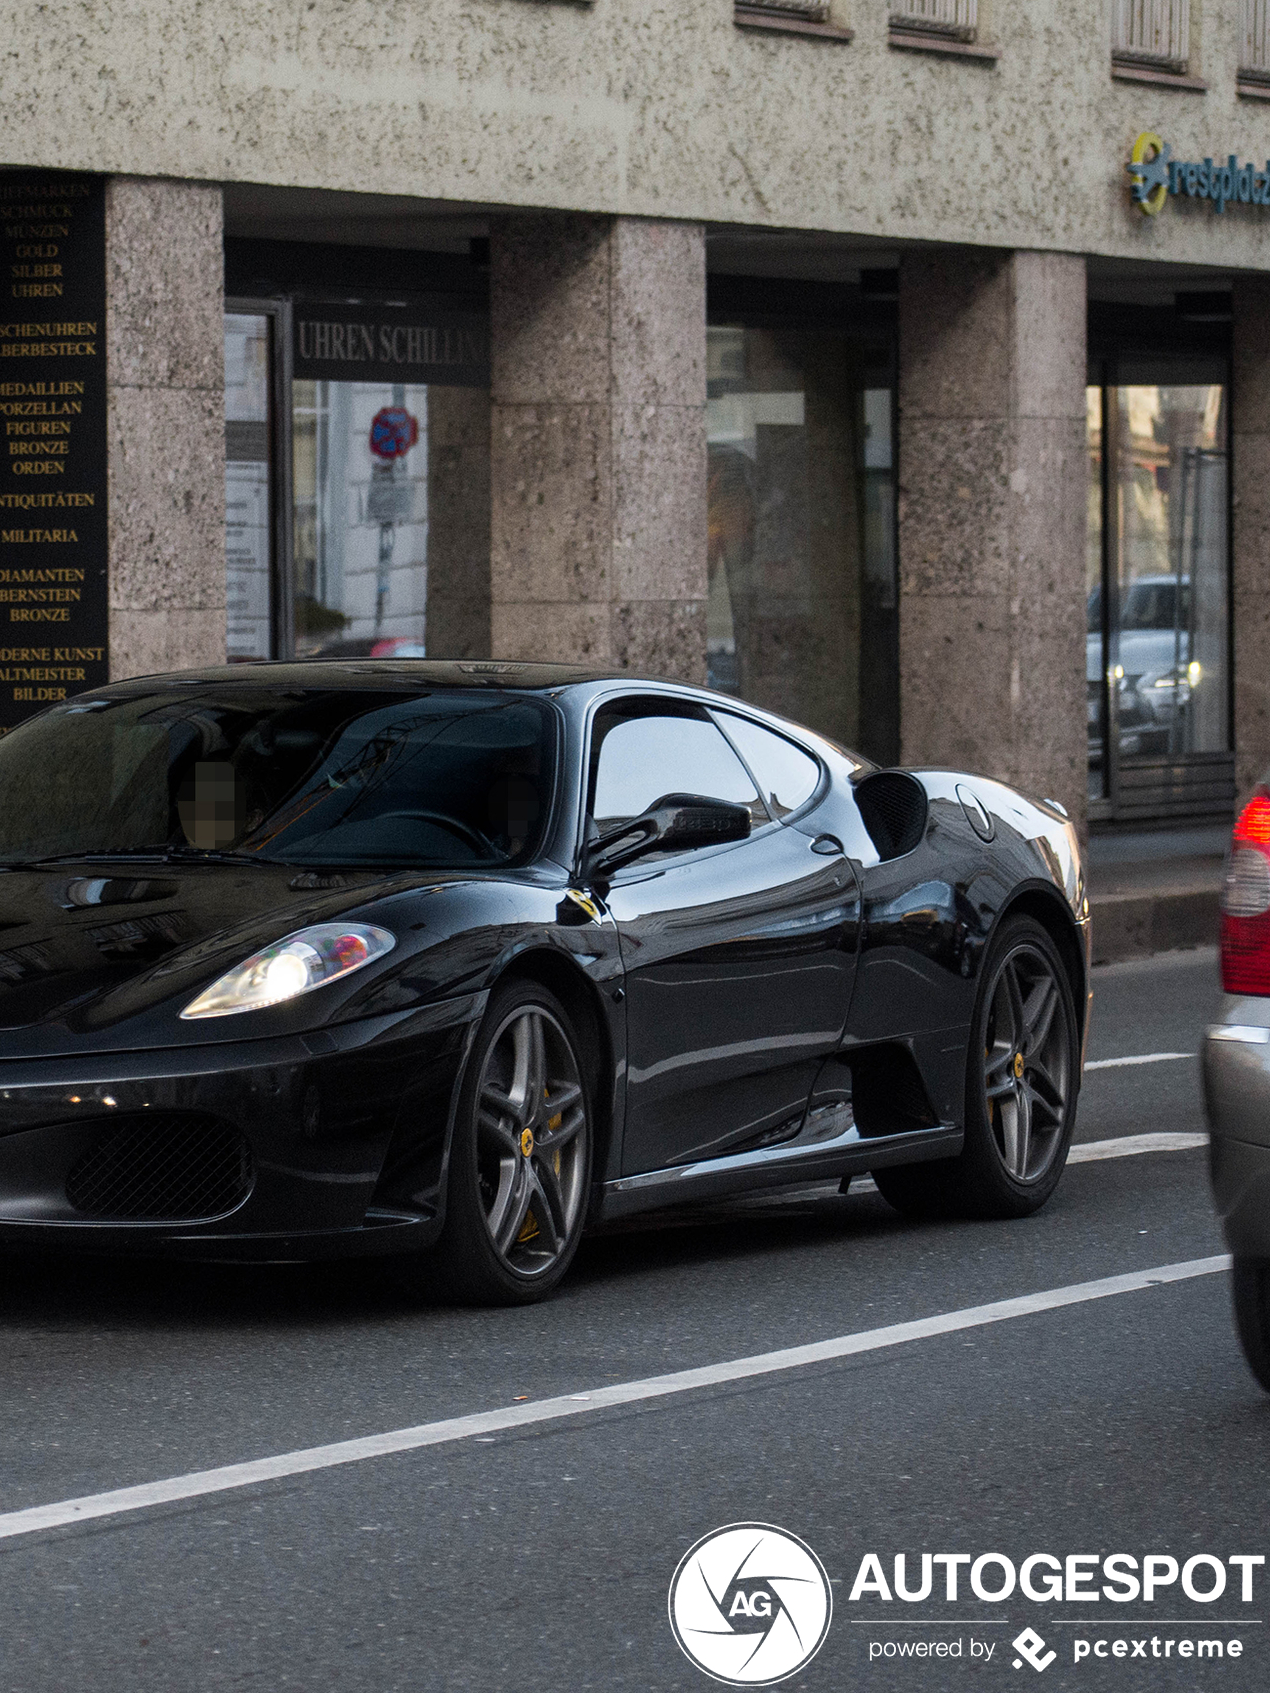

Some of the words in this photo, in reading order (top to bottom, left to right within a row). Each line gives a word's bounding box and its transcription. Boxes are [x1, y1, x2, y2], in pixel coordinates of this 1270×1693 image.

[0, 204, 72, 218] SCHMUCK
[16, 243, 58, 258] GOLD
[11, 263, 63, 277] SILBER
[12, 283, 64, 298] UHREN
[298, 321, 374, 361] UHREN
[6, 421, 71, 435] FIGUREN
[9, 441, 69, 455] BRONZE
[12, 461, 65, 475] ORDEN
[1, 529, 79, 544] MILITARIA
[0, 588, 81, 603] BERNSTEIN
[9, 608, 70, 622] BRONZE
[54, 647, 105, 661] KUNST
[13, 687, 67, 701] BILDER
